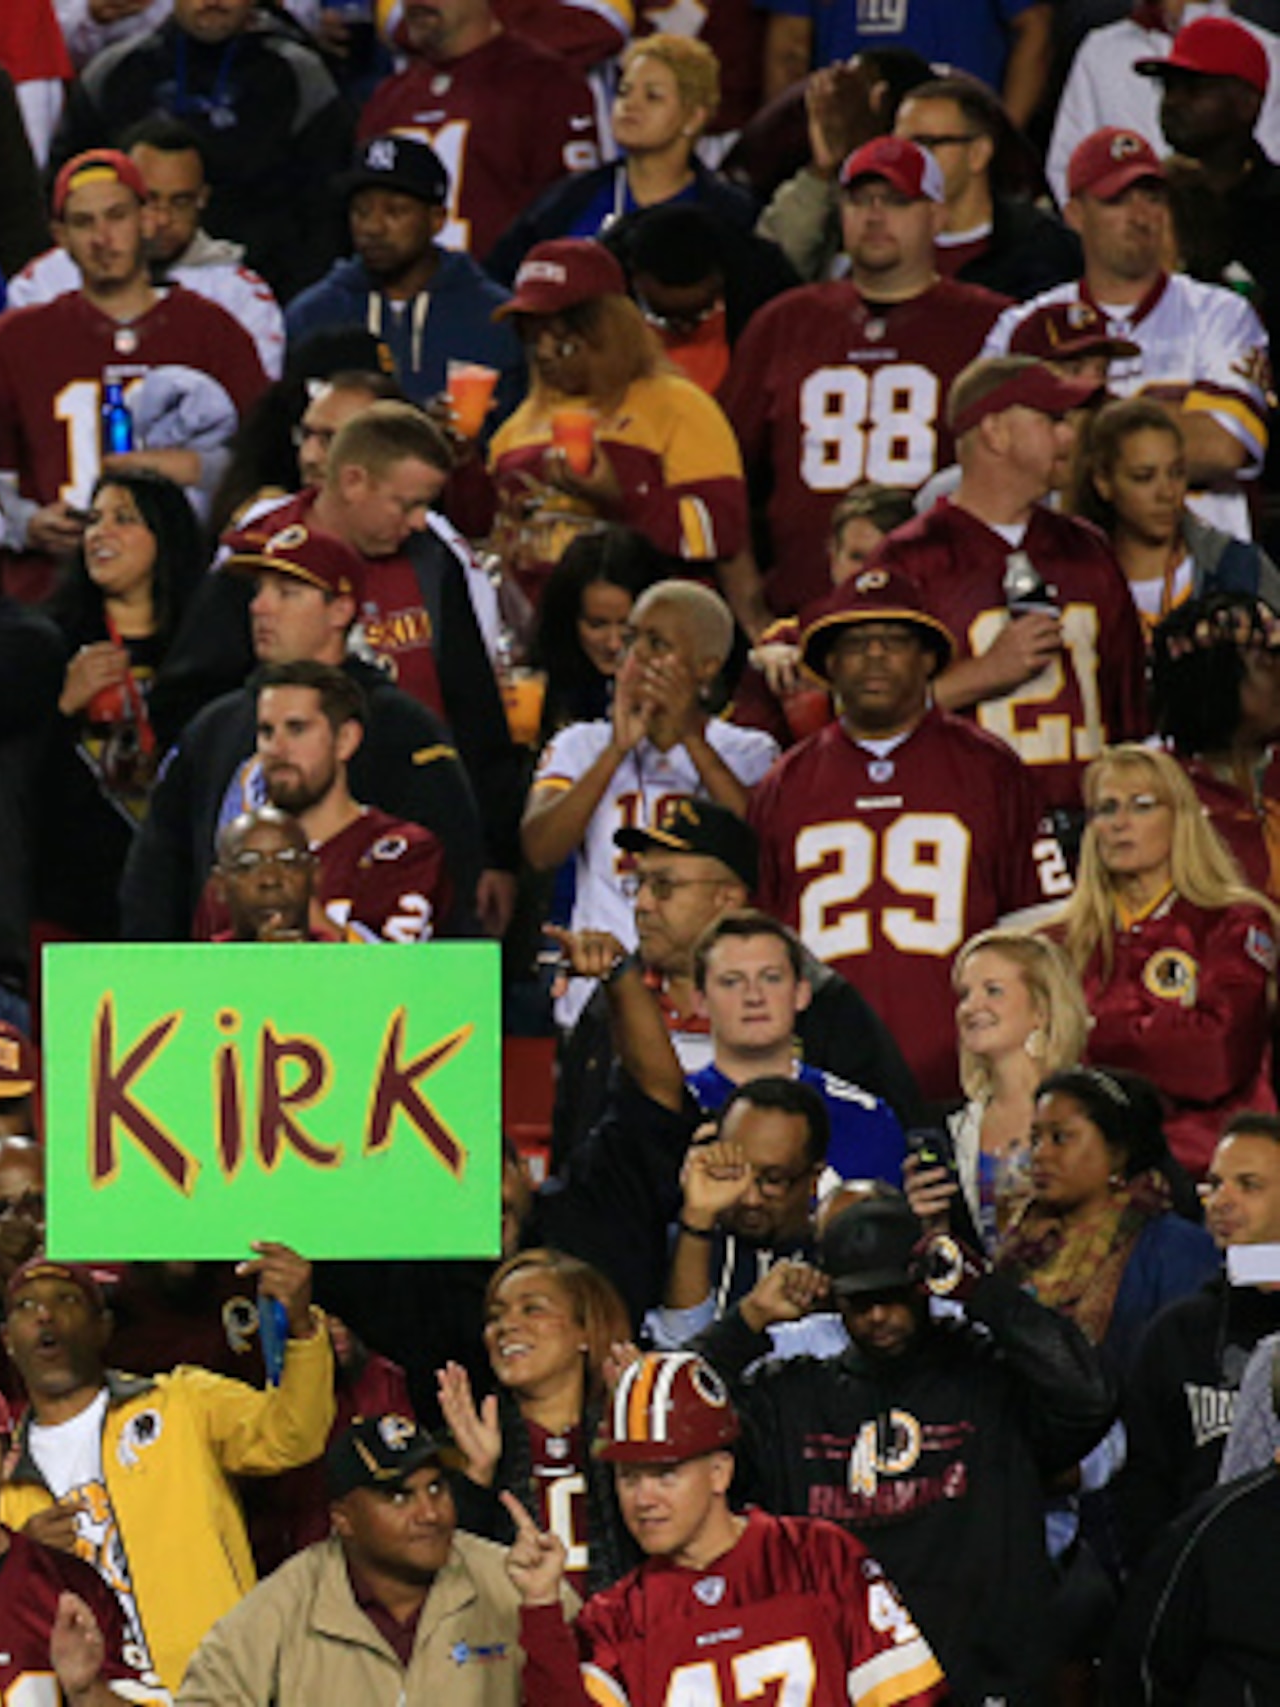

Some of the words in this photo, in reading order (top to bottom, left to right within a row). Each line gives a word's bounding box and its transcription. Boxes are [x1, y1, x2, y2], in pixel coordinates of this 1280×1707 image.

[800, 365, 938, 491] 88
[970, 602, 1108, 766] 21
[795, 813, 972, 959] 29
